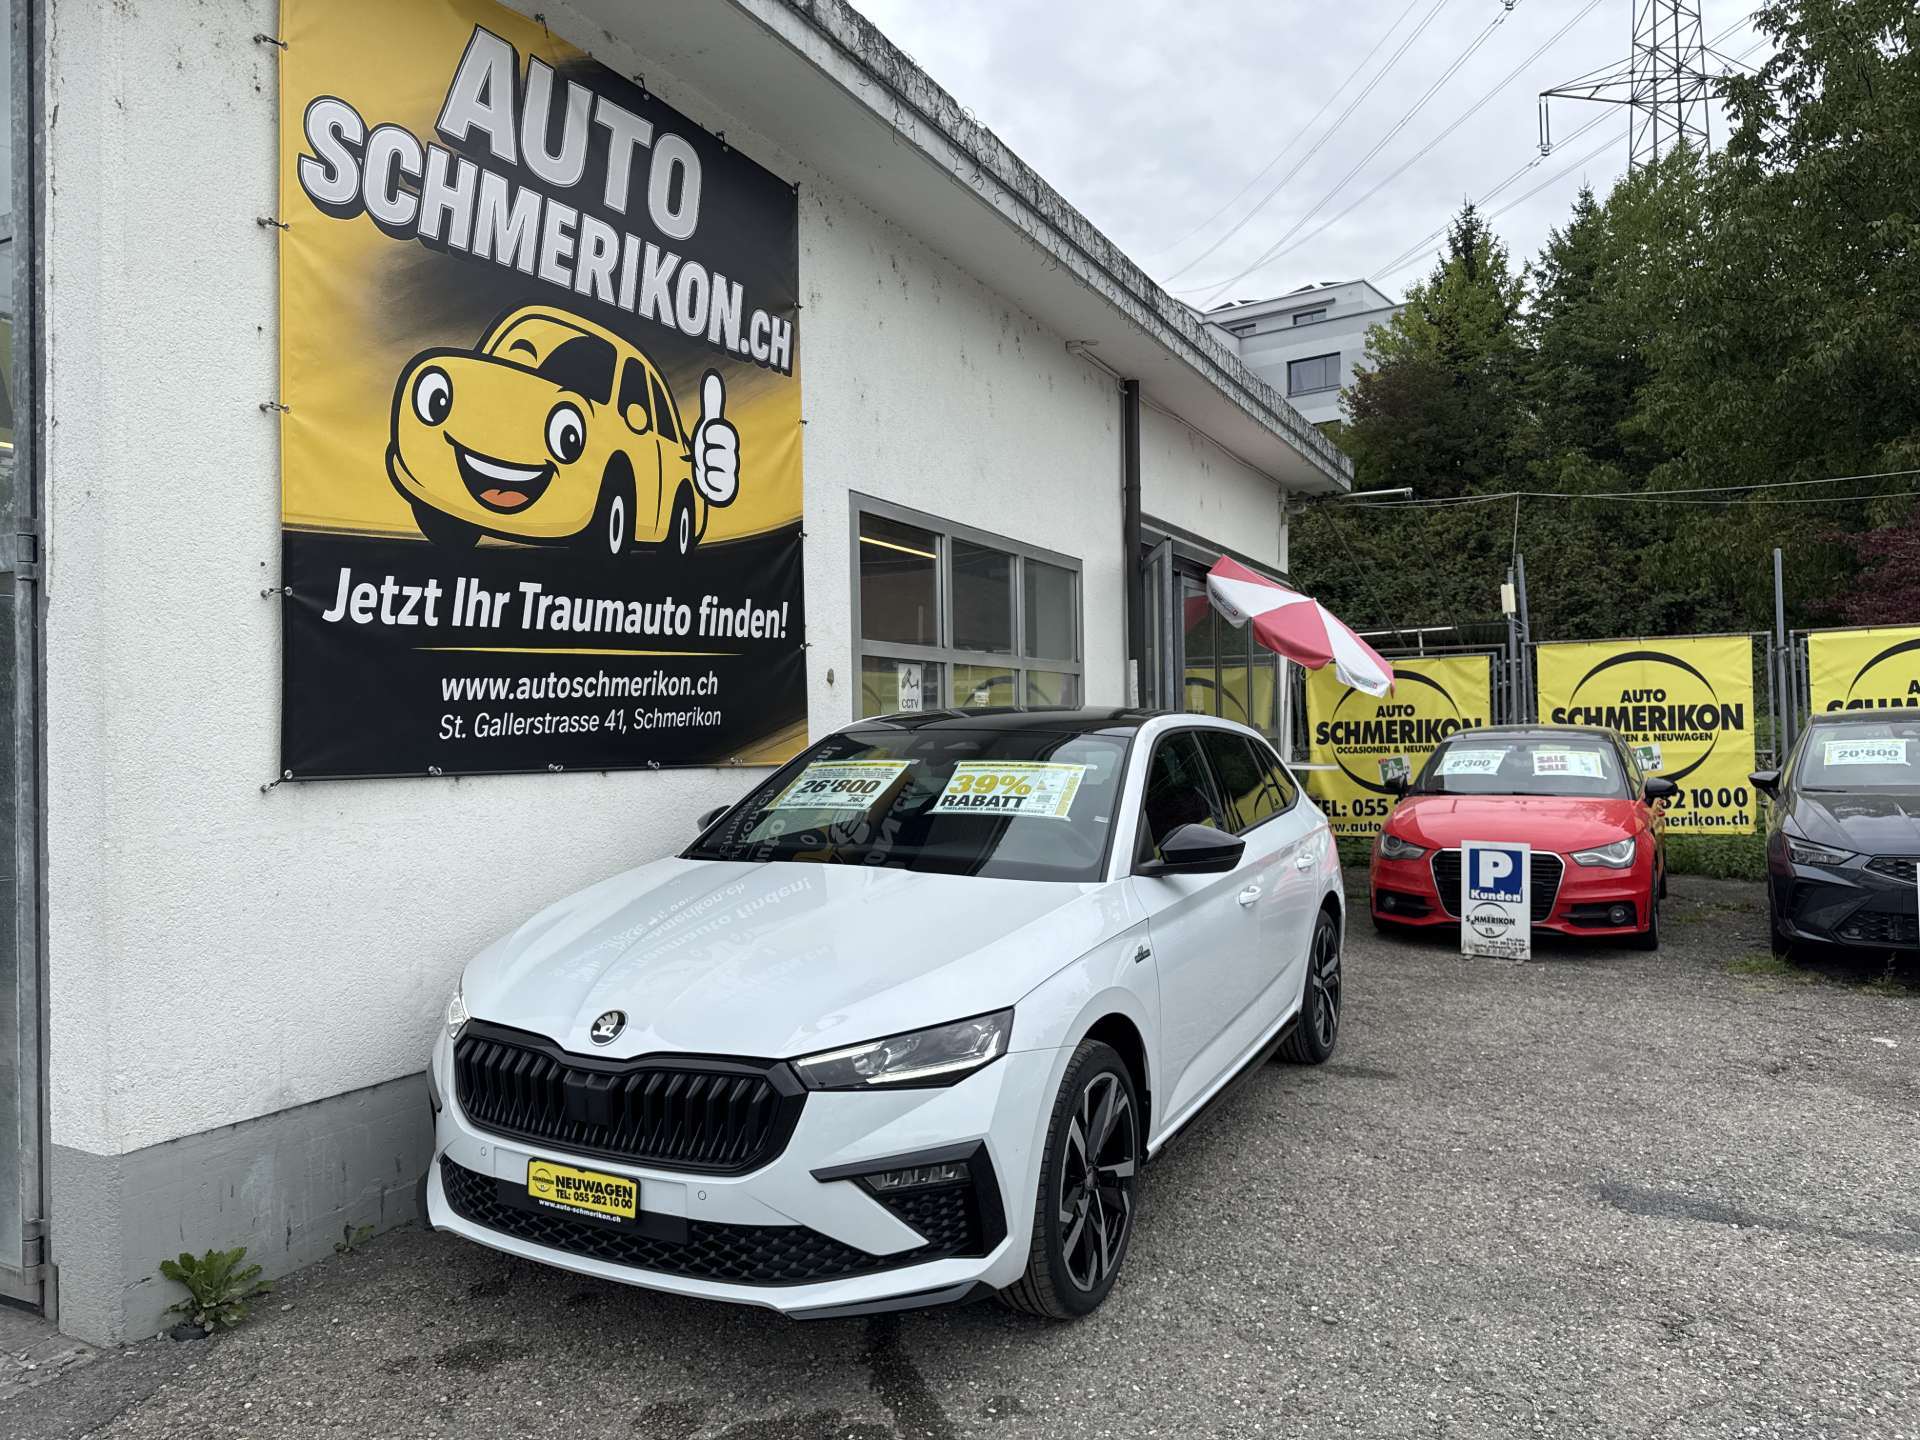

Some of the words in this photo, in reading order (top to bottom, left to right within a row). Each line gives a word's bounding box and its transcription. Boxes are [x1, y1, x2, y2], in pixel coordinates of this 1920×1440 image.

[438, 25, 701, 241] AUTO
[298, 97, 793, 371] SCHMERIKON.CH
[322, 567, 441, 625] Jetzt
[451, 577, 510, 629] Ihr
[518, 581, 691, 636] Traumauto
[698, 595, 788, 639] finden!
[441, 670, 718, 702] www.autoschmerikon.ch
[1620, 689, 1666, 703] AUTO
[901, 699, 920, 709] CCTV
[1375, 704, 1415, 718] AUTO
[439, 714, 467, 740] St.
[474, 710, 600, 738] Gallerstrasse
[604, 709, 627, 735] 41,
[633, 706, 721, 730] Schmerikon
[1551, 703, 1744, 732] SCHMERIKON
[1642, 733, 1650, 742] &
[1653, 732, 1713, 742] NEUWAGEN
[1336, 745, 1391, 754] OCCASIONEN
[1404, 745, 1436, 753] NEUWA
[796, 780, 882, 794] 26'800
[948, 774, 1032, 796] 39%
[940, 795, 1027, 808] RABATT
[1352, 798, 1389, 817] 055
[1691, 788, 1708, 809] 10
[1717, 787, 1749, 809] 00
[1479, 850, 1514, 888] P
[1471, 889, 1521, 902] Kunden
[555, 1175, 633, 1199] NEUWAGEN
[556, 1189, 571, 1200] TEL:
[573, 1192, 590, 1202] 055
[591, 1195, 607, 1206] 282
[610, 1198, 620, 1207] 10
[621, 1198, 632, 1209] 00
[538, 1199, 621, 1223] www.auto-schmerikon.ch
